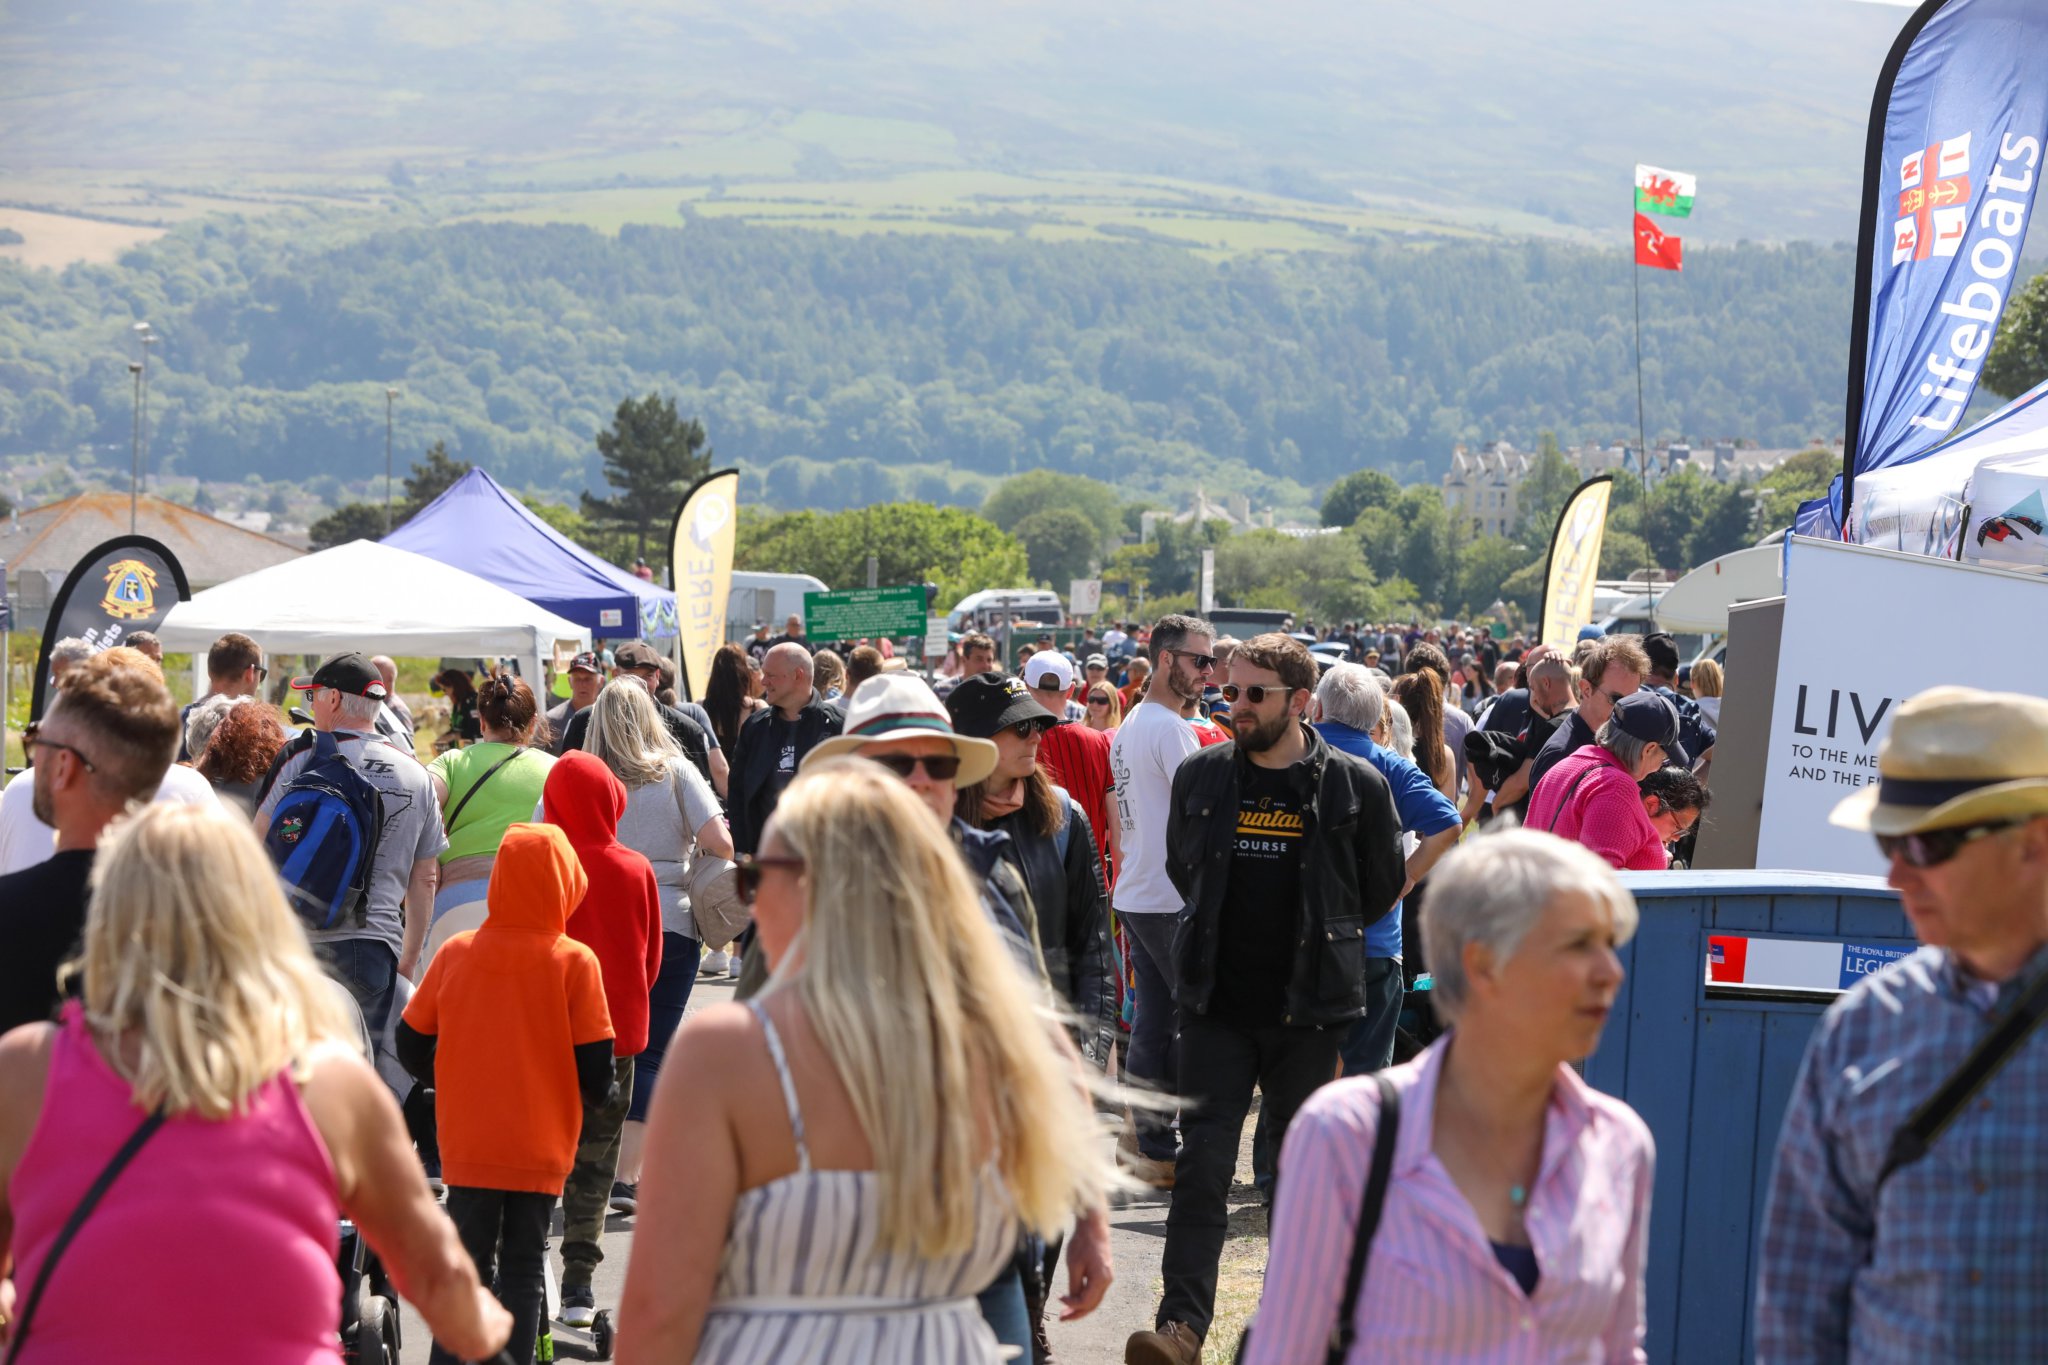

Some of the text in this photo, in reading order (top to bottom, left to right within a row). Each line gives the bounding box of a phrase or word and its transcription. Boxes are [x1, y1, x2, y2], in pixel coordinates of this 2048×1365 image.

[1910, 132, 2040, 432] Lifeboats
[1794, 684, 1906, 746] LIV
[1792, 744, 1881, 769] TO THE ME
[1789, 765, 1826, 781] AND
[1833, 770, 1861, 787] THE
[1848, 944, 1861, 954] THE
[1862, 946, 1884, 957] ROYAL
